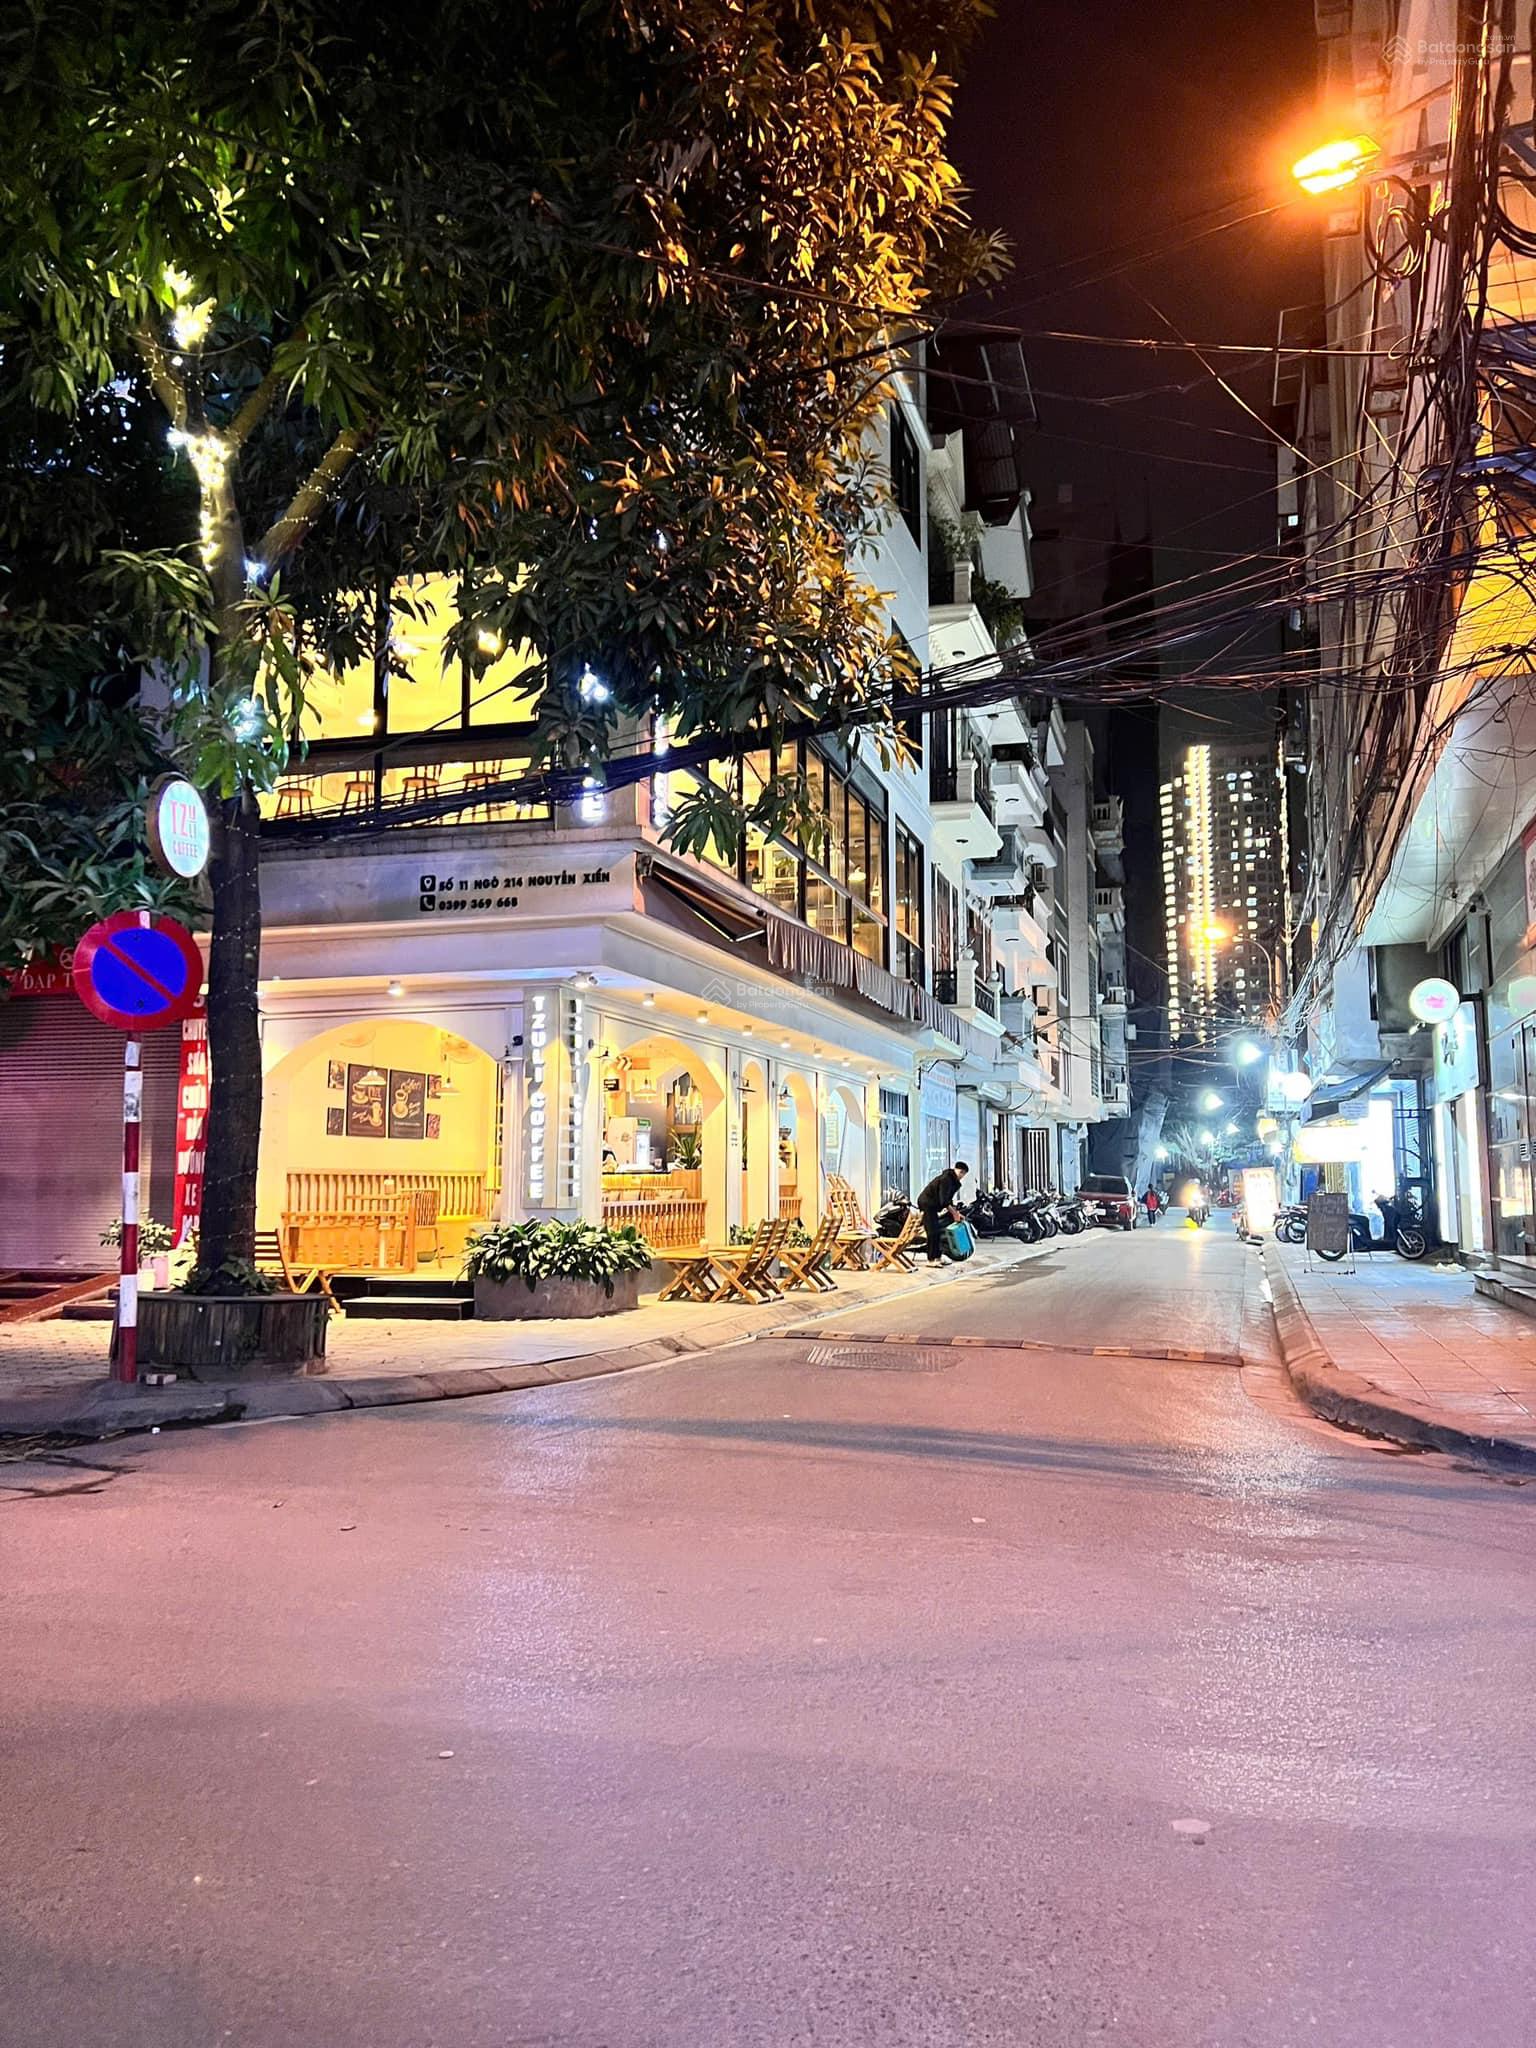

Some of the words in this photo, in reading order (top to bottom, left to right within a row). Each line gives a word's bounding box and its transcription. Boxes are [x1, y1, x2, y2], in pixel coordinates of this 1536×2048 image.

[459, 880, 469, 891] 11
[503, 877, 523, 889] 214
[438, 900, 468, 912] 0399
[470, 898, 493, 910] 369
[496, 897, 519, 908] 668
[531, 996, 546, 1083] TZULI
[529, 1092, 546, 1199] COFFEE
[184, 1183, 197, 1206] XE
